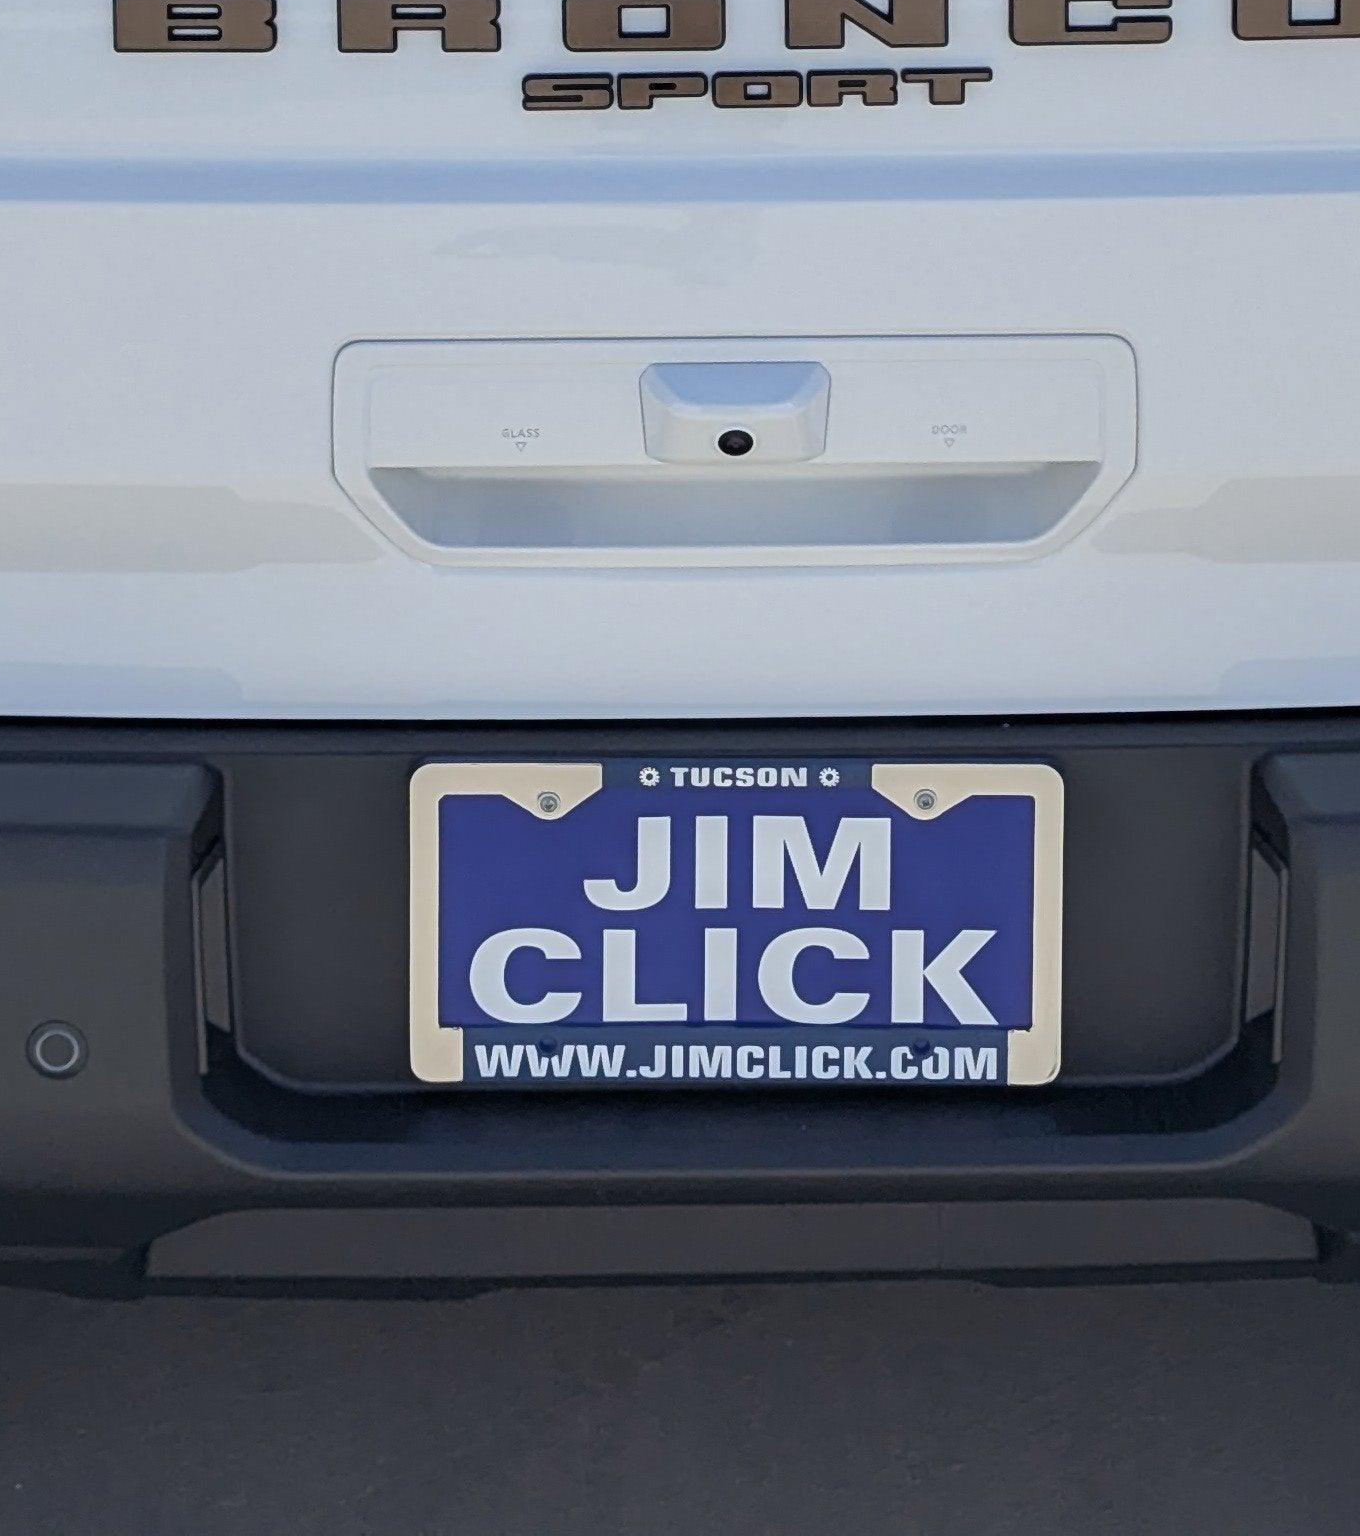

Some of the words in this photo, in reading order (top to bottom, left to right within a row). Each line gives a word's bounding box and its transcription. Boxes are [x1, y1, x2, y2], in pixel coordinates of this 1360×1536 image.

[521, 67, 994, 111] SPORT
[501, 427, 541, 439] GLASS
[670, 767, 808, 788] TUCSON
[583, 815, 892, 911] JIM
[469, 927, 999, 1026] CLICK
[474, 1043, 999, 1081] WWW.JIMCLICK.COM
